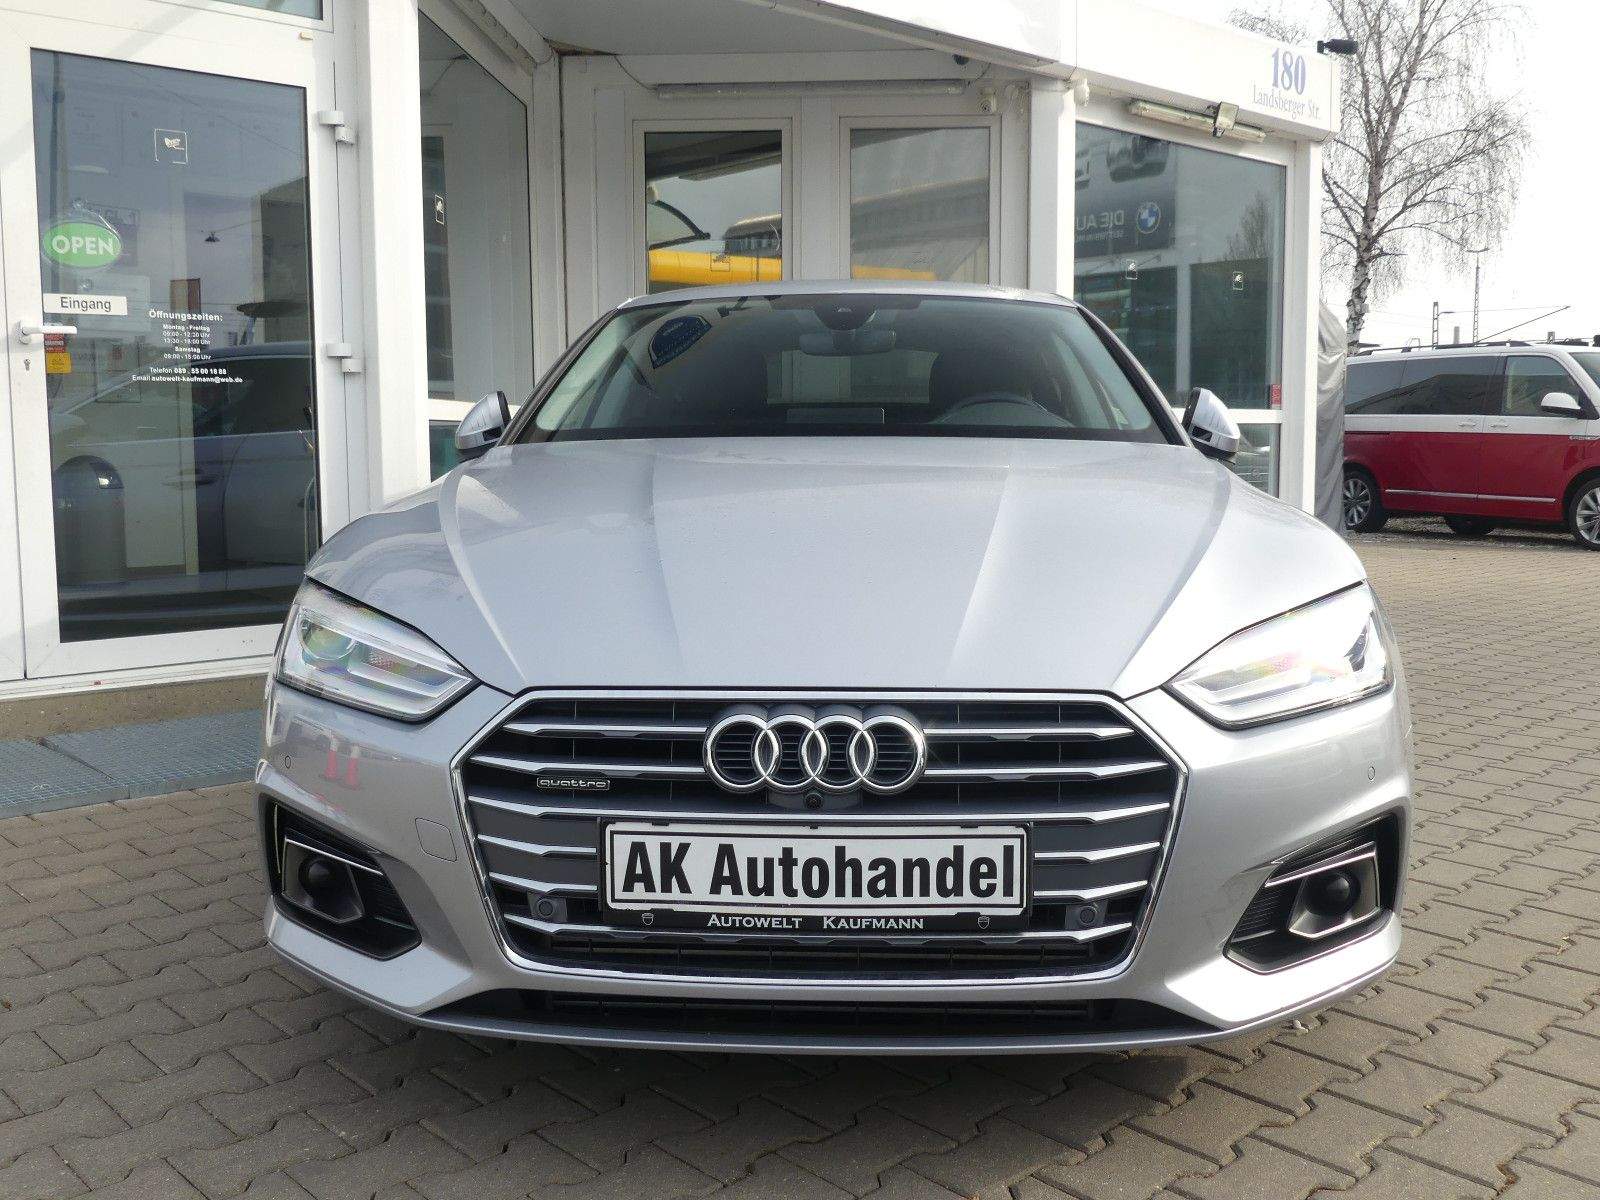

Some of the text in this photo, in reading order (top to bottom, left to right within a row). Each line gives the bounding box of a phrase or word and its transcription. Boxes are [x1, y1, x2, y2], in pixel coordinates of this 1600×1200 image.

[1272, 48, 1306, 95] 180
[1253, 83, 1305, 120] Landsberger
[52, 234, 114, 256] OPEN
[60, 296, 111, 312] Eingang
[148, 309, 223, 322] Öffnungszeiten:
[149, 366, 173, 374] Telefon
[151, 375, 243, 384] autowelt-kaufmann@web.de
[540, 779, 607, 788] quattro
[622, 840, 1015, 899] AK Autohandel
[707, 914, 924, 930] AUTOWELT KAUFMANN
